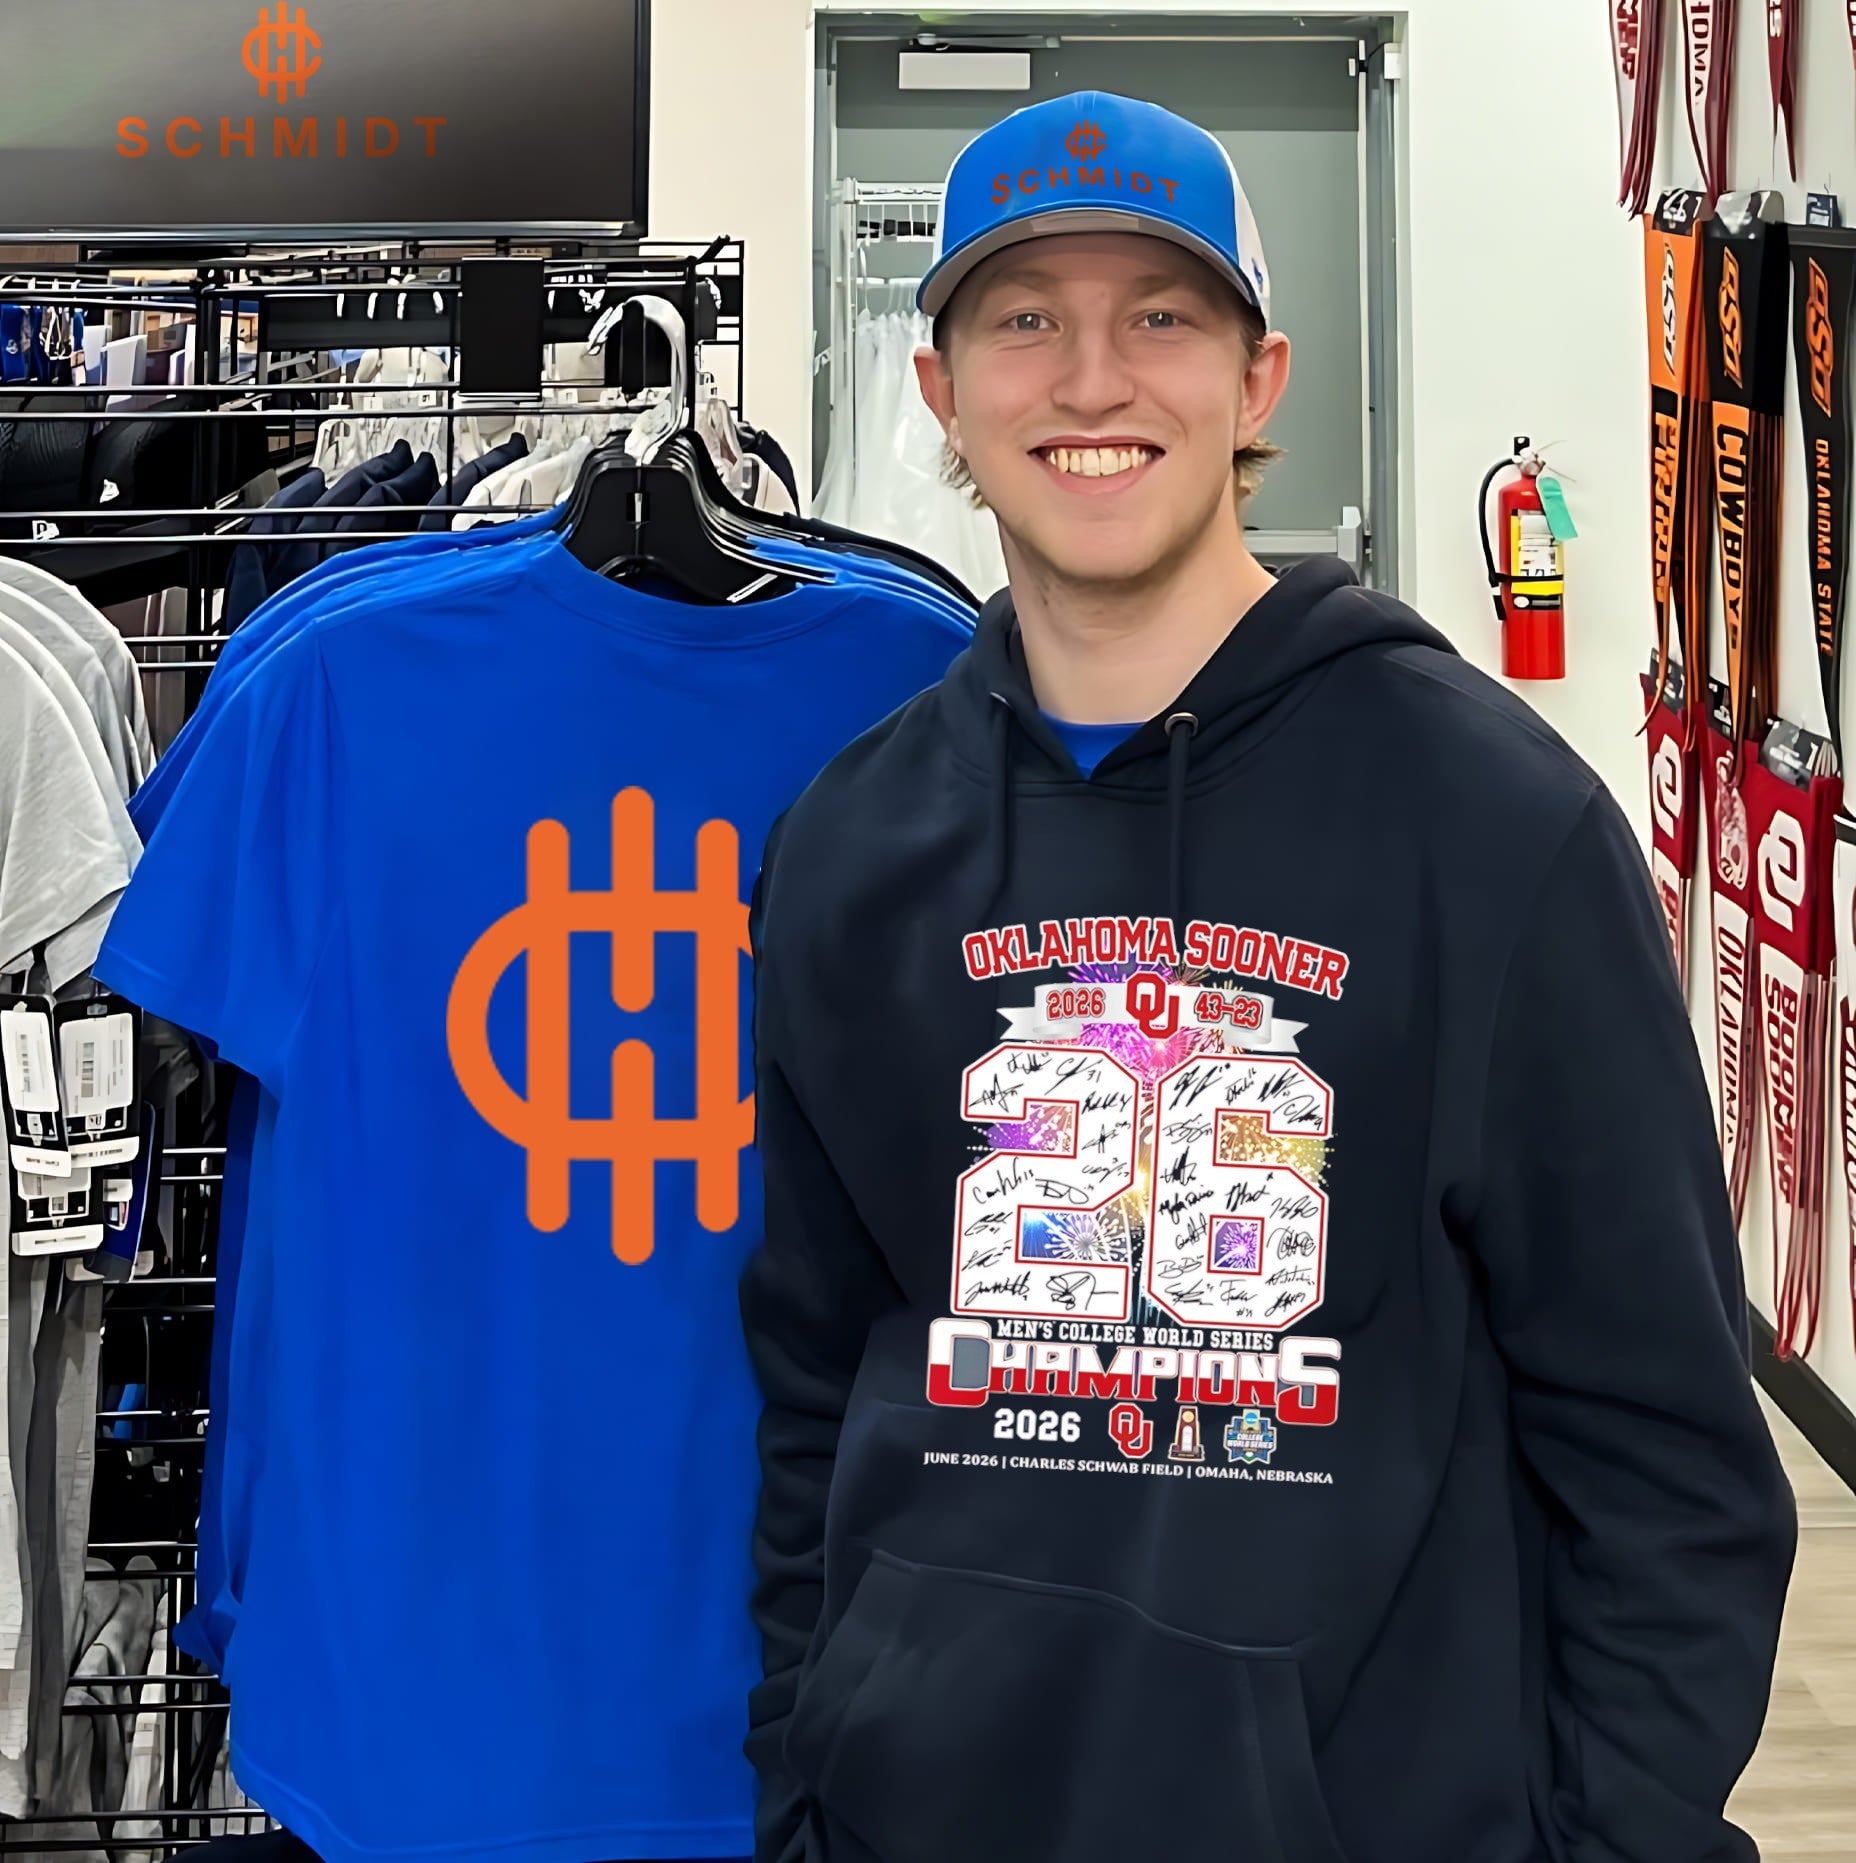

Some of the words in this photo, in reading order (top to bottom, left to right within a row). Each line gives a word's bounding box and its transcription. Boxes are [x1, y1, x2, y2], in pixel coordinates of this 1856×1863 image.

[115, 116, 447, 159] SCHMIDT
[991, 166, 1179, 205] SCHMIDT
[1815, 438, 1832, 570] OKLAHOMA
[960, 916, 1178, 981] OKLAHOMA
[1184, 920, 1350, 1000] SOONER
[1046, 988, 1105, 1020] 2026
[1193, 989, 1264, 1030] 43-23
[996, 1319, 1053, 1342] MEN'S
[1058, 1322, 1137, 1344] COLLEGE
[1142, 1326, 1205, 1348] WORLD
[1210, 1331, 1274, 1351] SERIES
[926, 1317, 1342, 1427] CHAMPIONS
[993, 1408, 1081, 1442] 2026
[923, 1451, 959, 1466] JUNE
[961, 1453, 999, 1467] 2026
[1009, 1456, 1076, 1472] CHARLES
[1077, 1460, 1139, 1475] SCHWAB
[1142, 1463, 1184, 1477] FIELD
[1195, 1466, 1254, 1481] OMAHA,
[1256, 1469, 1334, 1484] NEBRASKA
